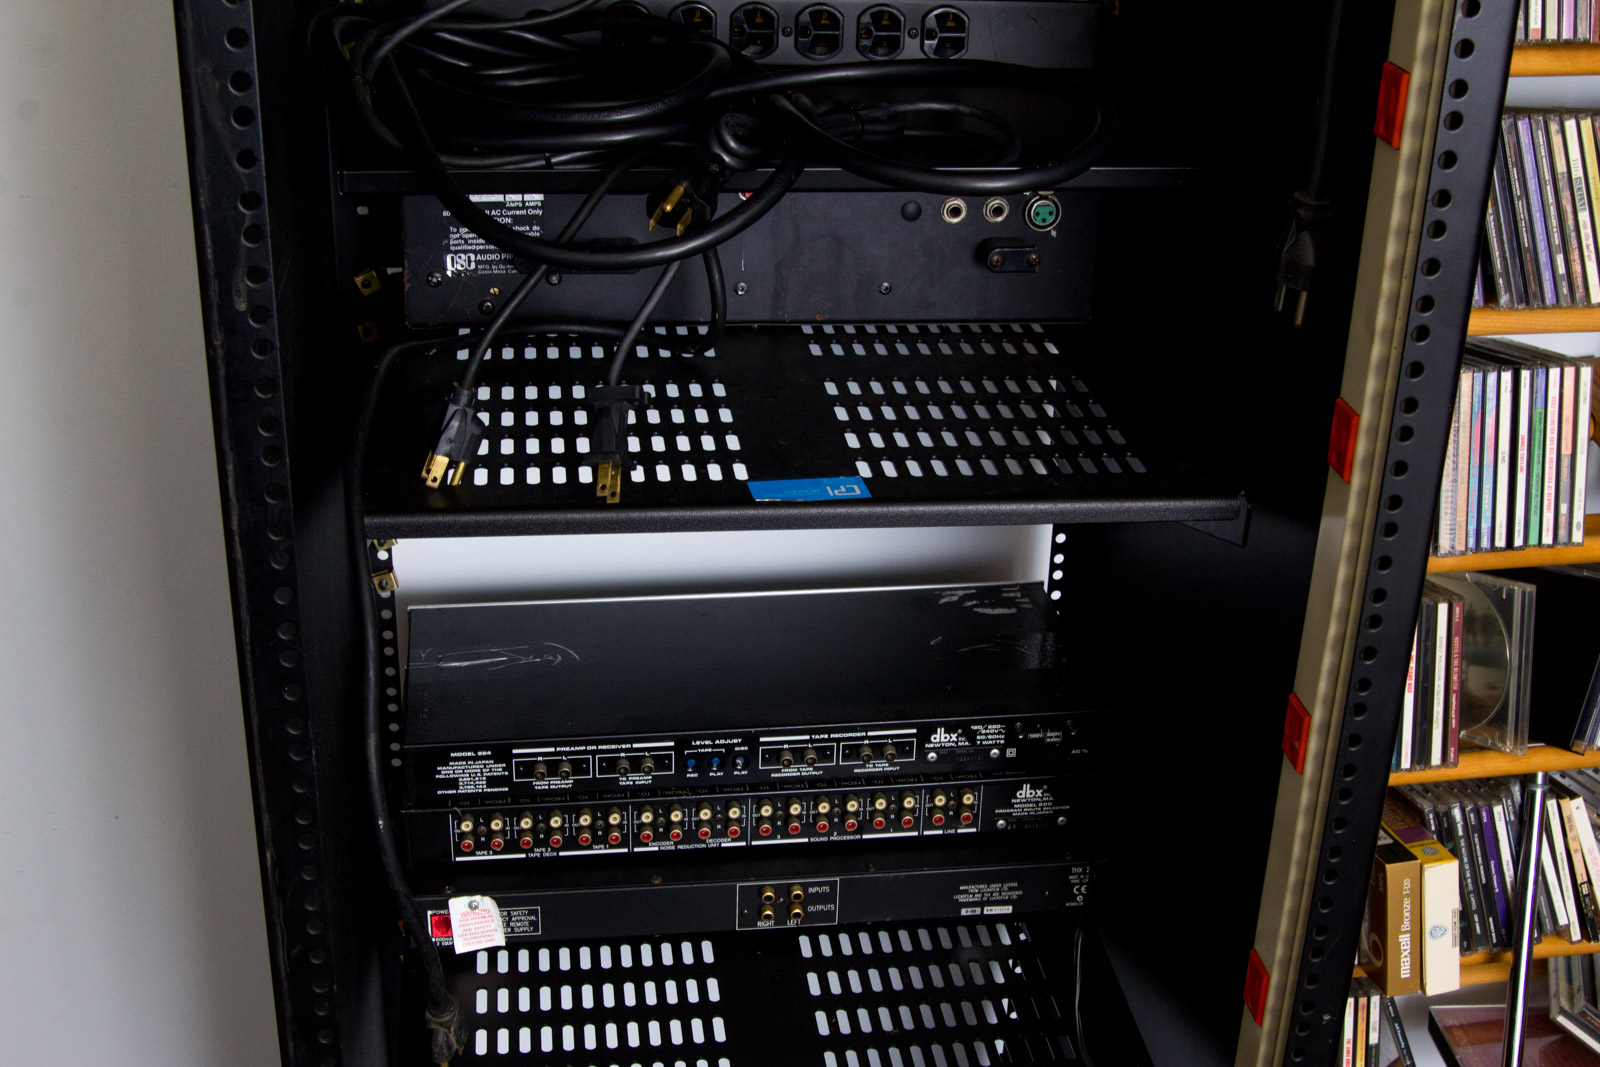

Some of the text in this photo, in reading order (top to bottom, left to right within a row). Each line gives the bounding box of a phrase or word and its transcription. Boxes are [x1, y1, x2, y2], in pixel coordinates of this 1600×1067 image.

[1572, 159, 1587, 212] BIG SUGAR
[447, 253, 475, 270] QSC
[826, 485, 861, 496] CPI
[930, 727, 958, 743] dbx
[1016, 783, 1043, 798] dbx
[1402, 897, 1411, 931] Bronze
[1399, 933, 1411, 978] maxell
